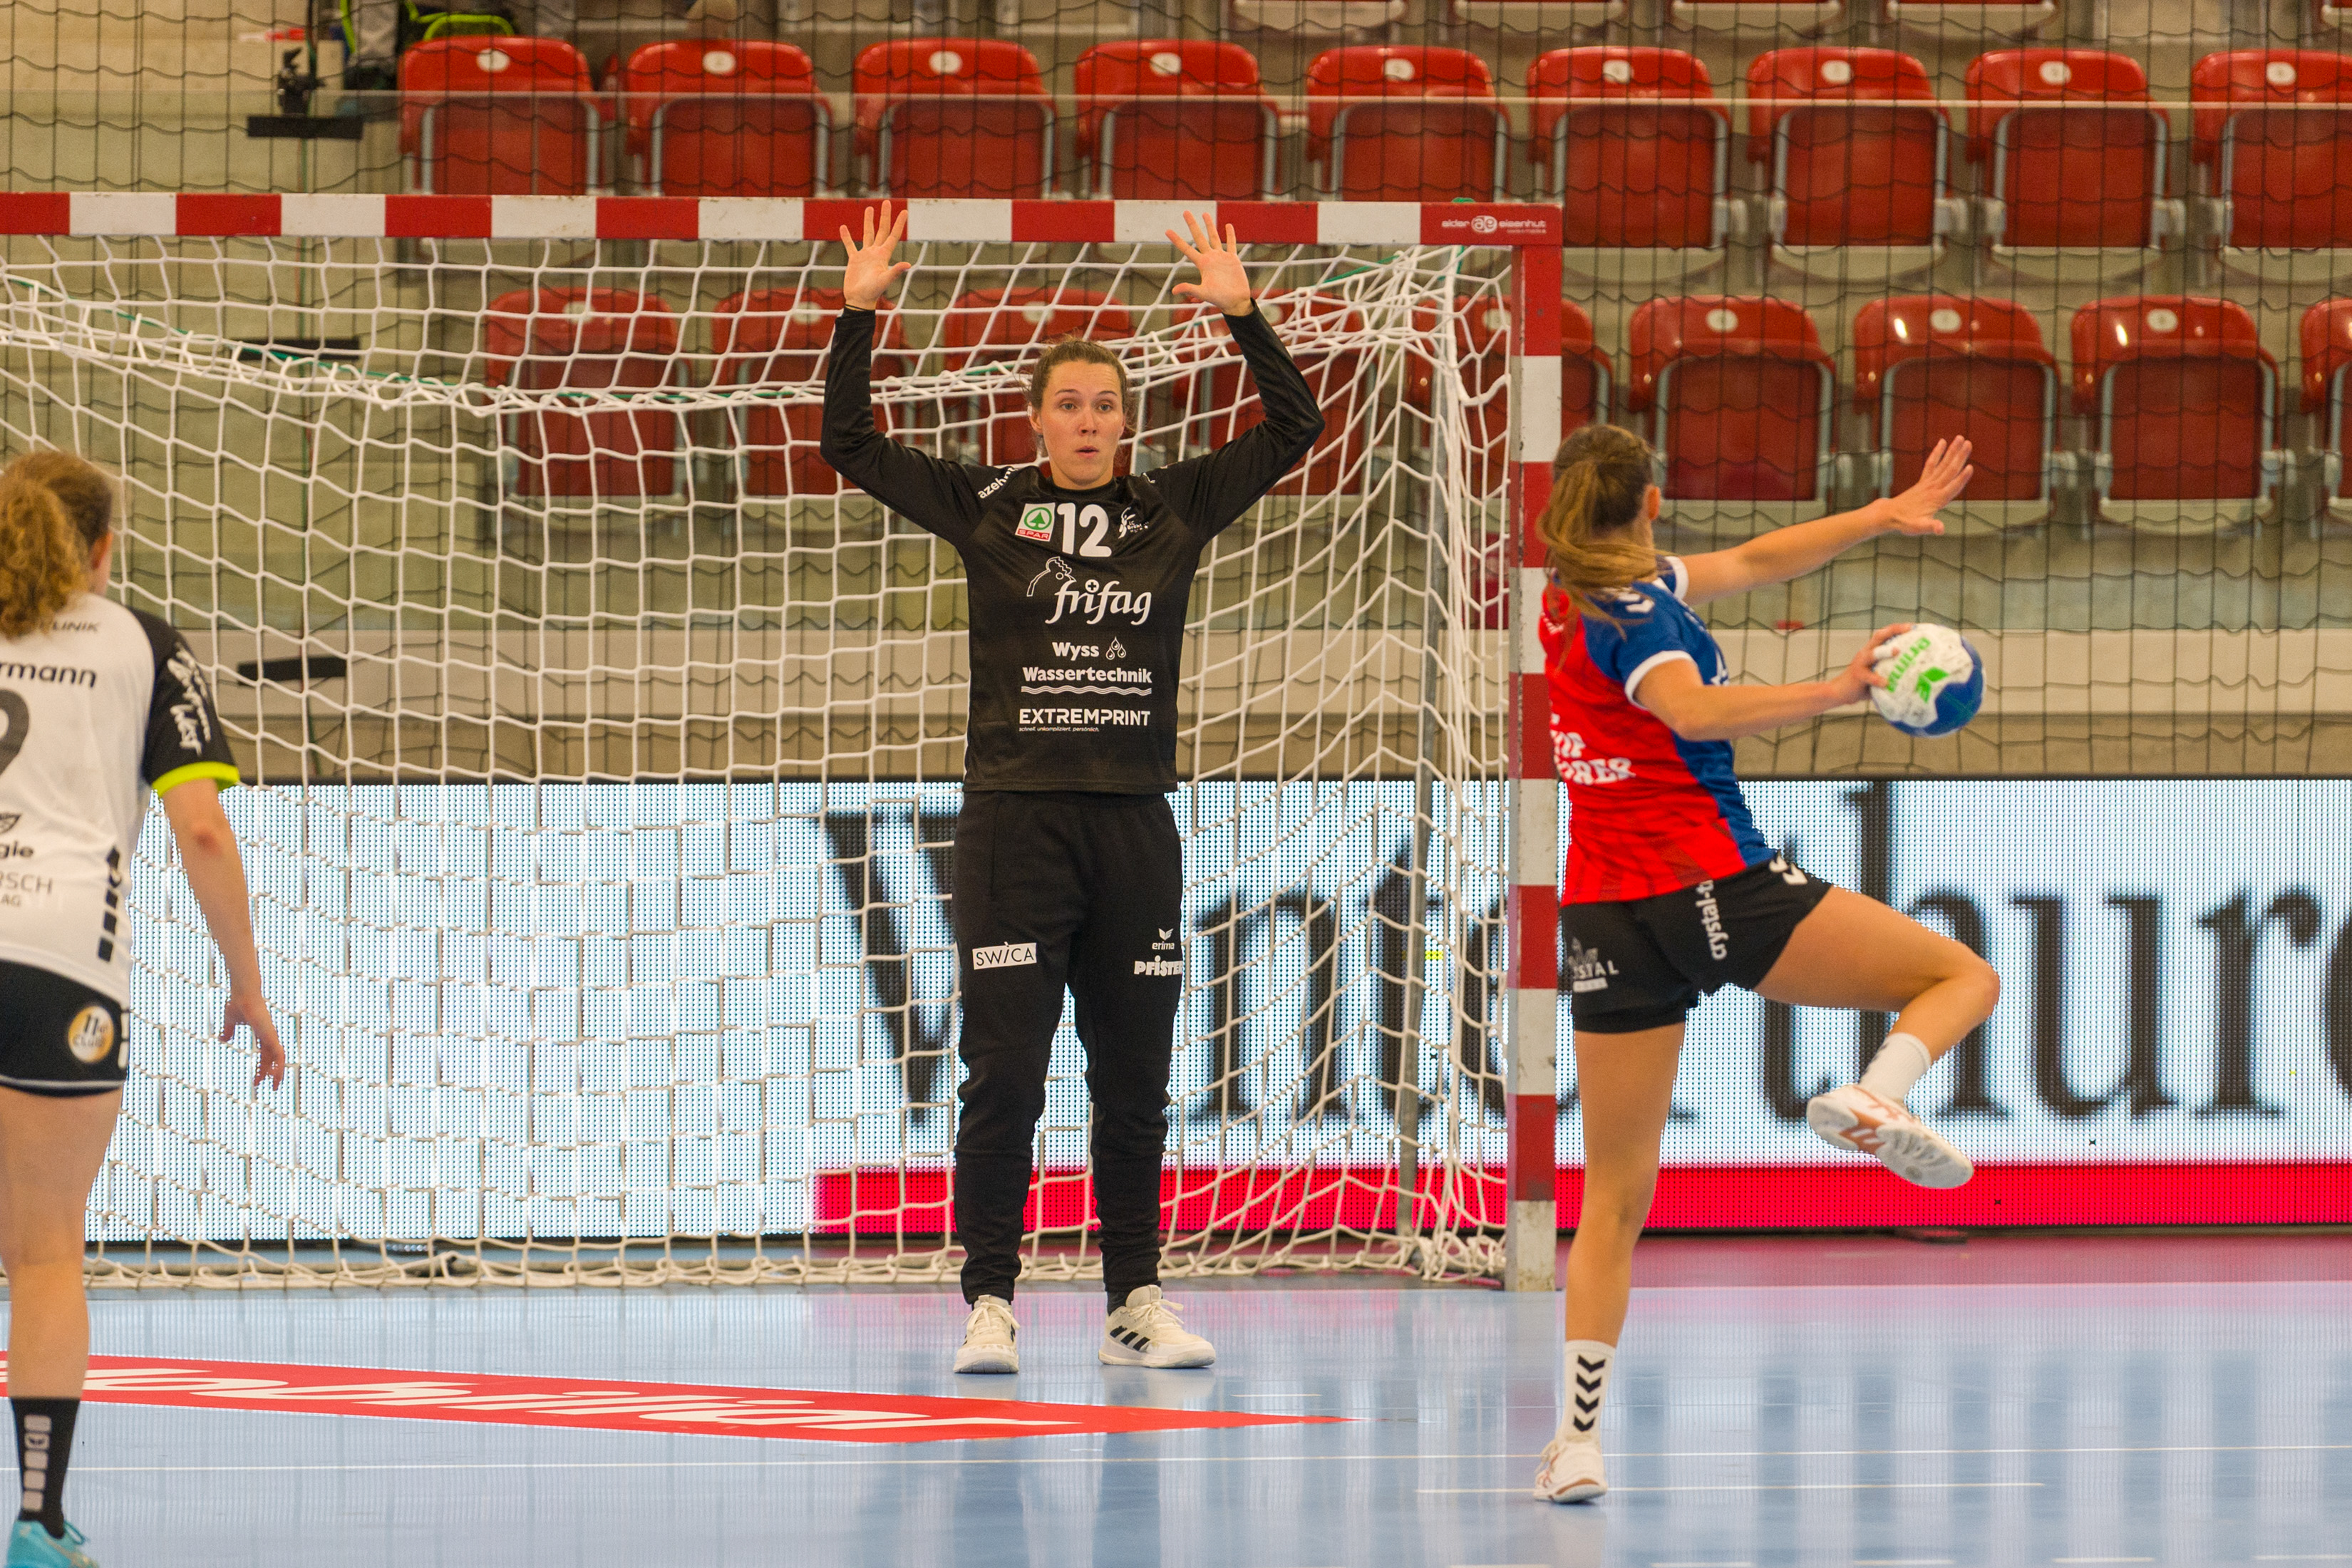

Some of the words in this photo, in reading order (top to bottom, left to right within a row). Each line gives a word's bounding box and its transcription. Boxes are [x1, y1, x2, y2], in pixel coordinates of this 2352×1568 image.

[1018, 529, 1049, 540] SPAR
[1056, 502, 1112, 557] 12
[1045, 579, 1152, 626] frifag
[1052, 641, 1100, 661] Wyss
[1886, 636, 1931, 693] erima
[1022, 666, 1152, 684] Wassertechnik
[1019, 708, 1151, 726] EXTREMPRINT
[1152, 941, 1175, 951] erima
